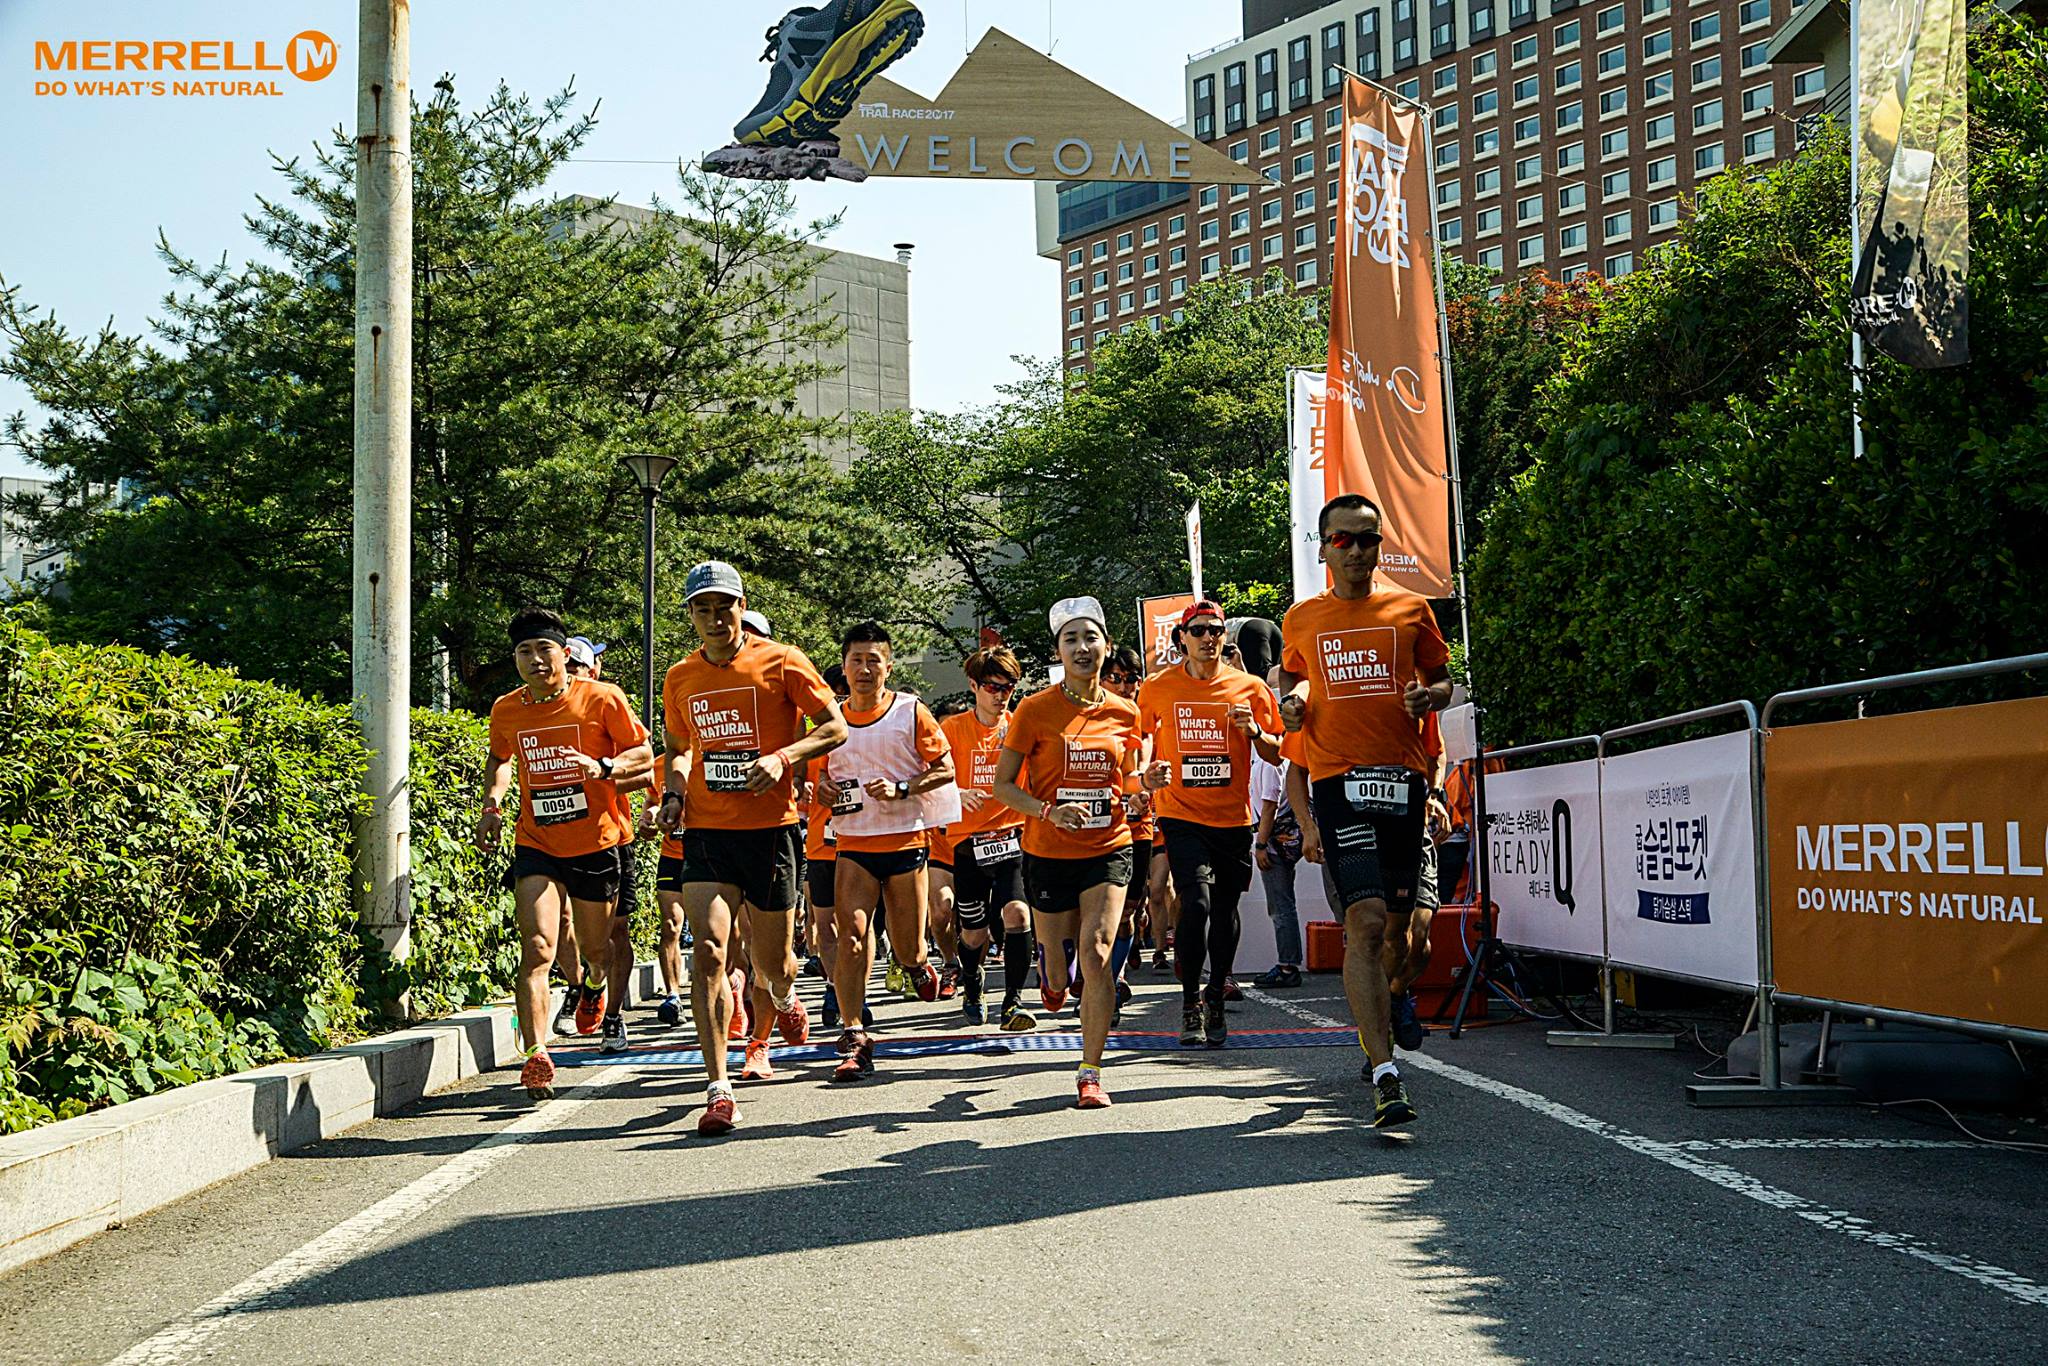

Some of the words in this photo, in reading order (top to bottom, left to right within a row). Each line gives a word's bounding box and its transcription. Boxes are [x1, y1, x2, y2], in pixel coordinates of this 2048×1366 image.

[859, 107, 891, 119] TRAIL
[892, 109, 924, 119] RACE
[855, 133, 1191, 178] WELCOME
[1323, 639, 1342, 653] DO
[1325, 649, 1378, 667] WHAT'S
[1328, 664, 1390, 682] NATURAL
[1360, 683, 1391, 691] MERRELL
[693, 699, 709, 714] DO
[1178, 707, 1192, 718] DO
[694, 709, 740, 727] WHAT'S
[1179, 718, 1216, 729] WHAT'S
[699, 721, 753, 739] NATURAL
[1180, 729, 1225, 740] NATURAL
[522, 736, 538, 748] DO
[1069, 741, 1082, 751] DO
[974, 755, 986, 765] DO
[1069, 751, 1106, 762] WHAT'S
[974, 764, 997, 774] WHAT
[1069, 761, 1112, 771] NATURAL
[1191, 765, 1221, 777] 0092
[973, 774, 995, 784] NATU
[1359, 782, 1395, 800] 0014
[542, 797, 575, 813] 0094
[1517, 809, 1550, 834] 숙취해소
[983, 842, 1010, 856] 0067
[1643, 814, 1708, 881] 슬림포켓
[1796, 821, 2043, 876] MERRELL
[1493, 839, 1550, 874] READY
[1653, 896, 1676, 920] 닭가슴살
[1678, 898, 1692, 921] 스틱
[1797, 887, 1825, 911] DO
[1830, 889, 1912, 916] WHAT'S
[1919, 892, 2043, 924] NATURAL
